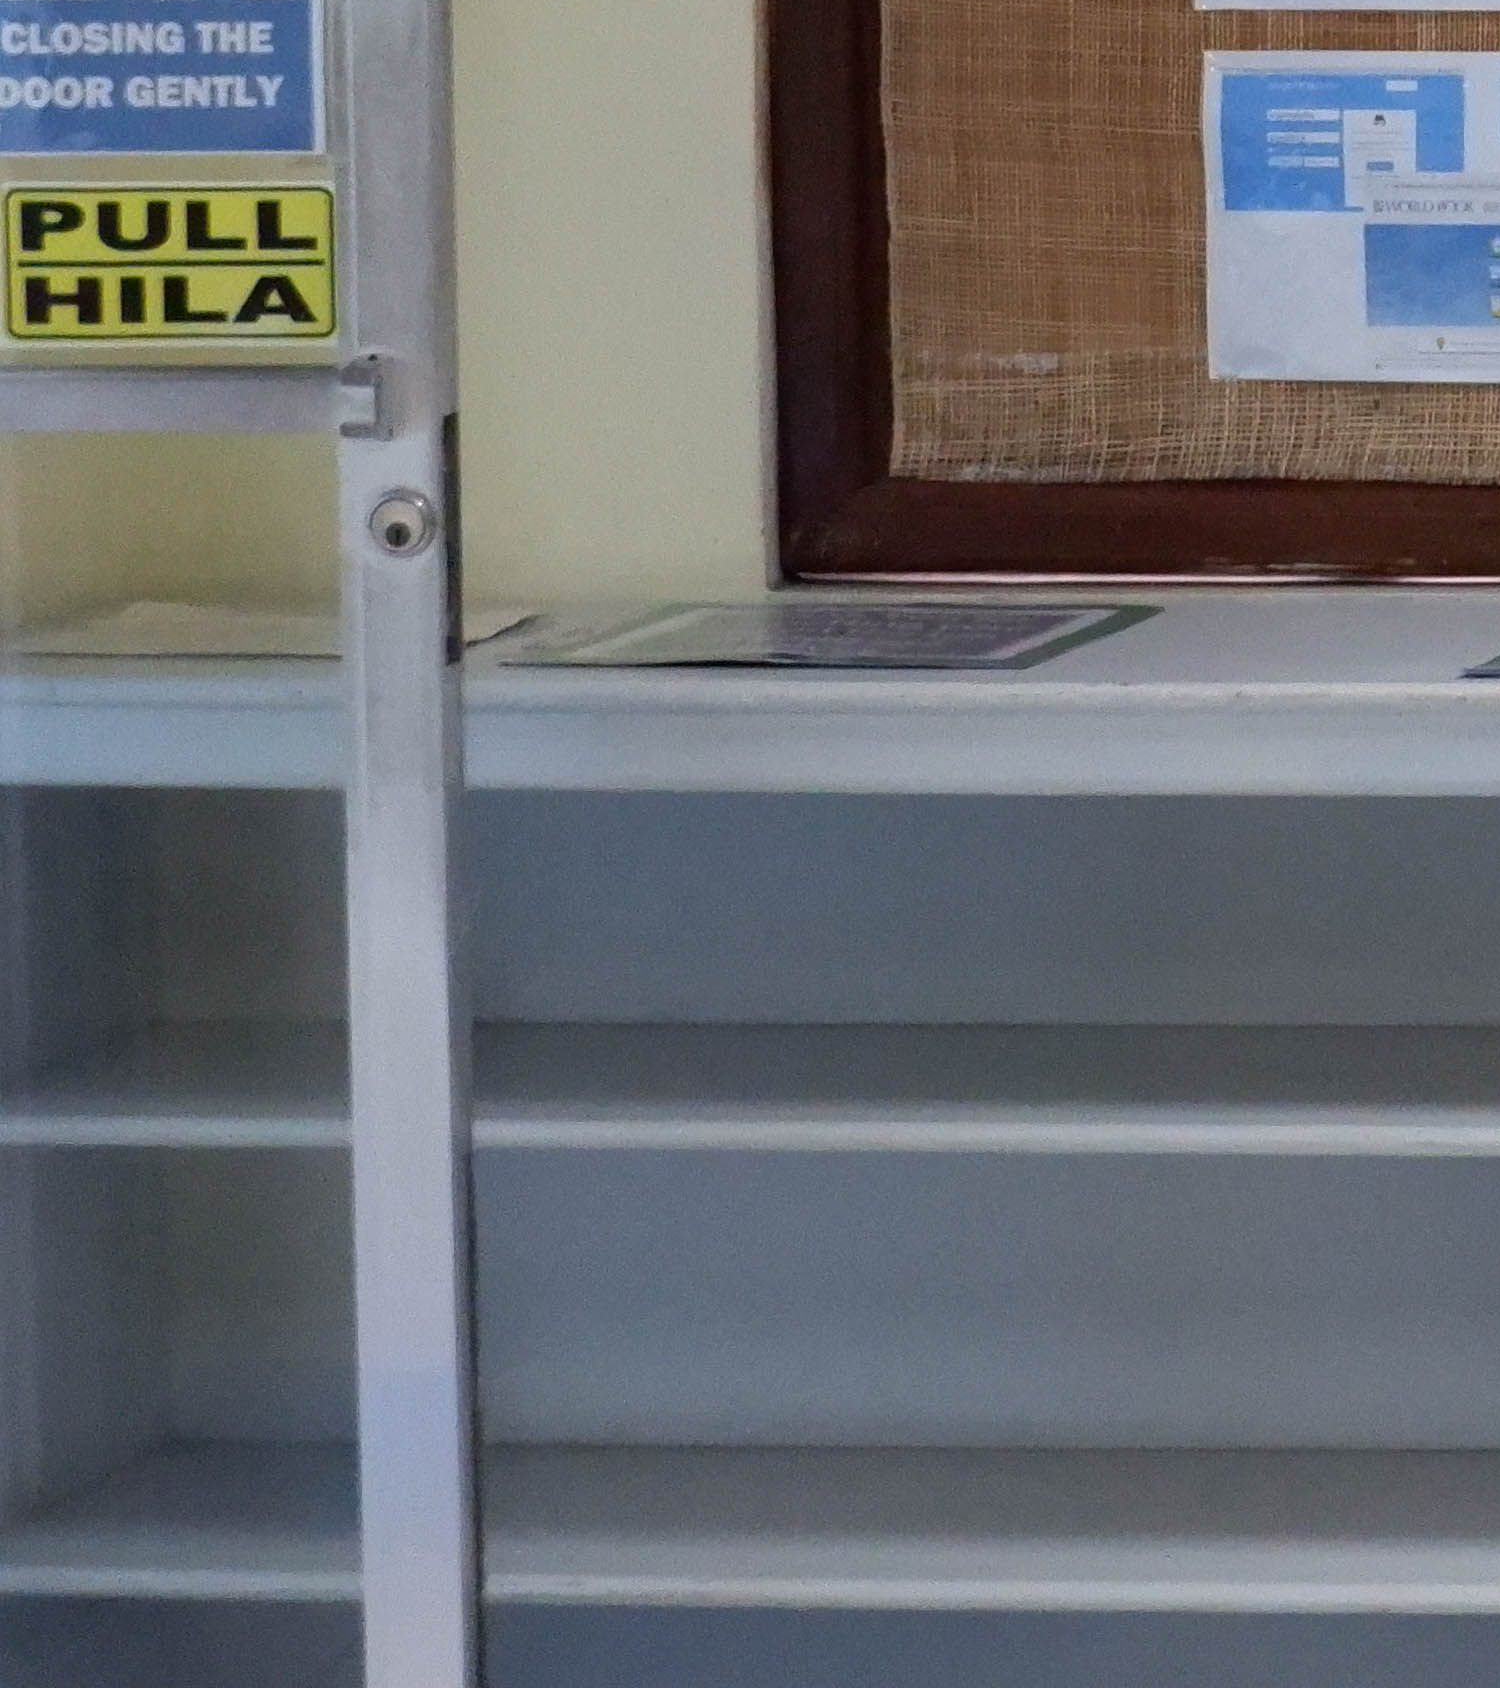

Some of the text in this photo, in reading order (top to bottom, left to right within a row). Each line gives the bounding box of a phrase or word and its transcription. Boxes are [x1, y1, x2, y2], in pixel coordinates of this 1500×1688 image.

[3, 22, 274, 55] CLOSING THE
[0, 75, 284, 108] DOOR GENTLY
[1384, 201, 1474, 213] WORLD BOOK
[20, 200, 318, 251] PULL
[25, 275, 318, 324] HILA
